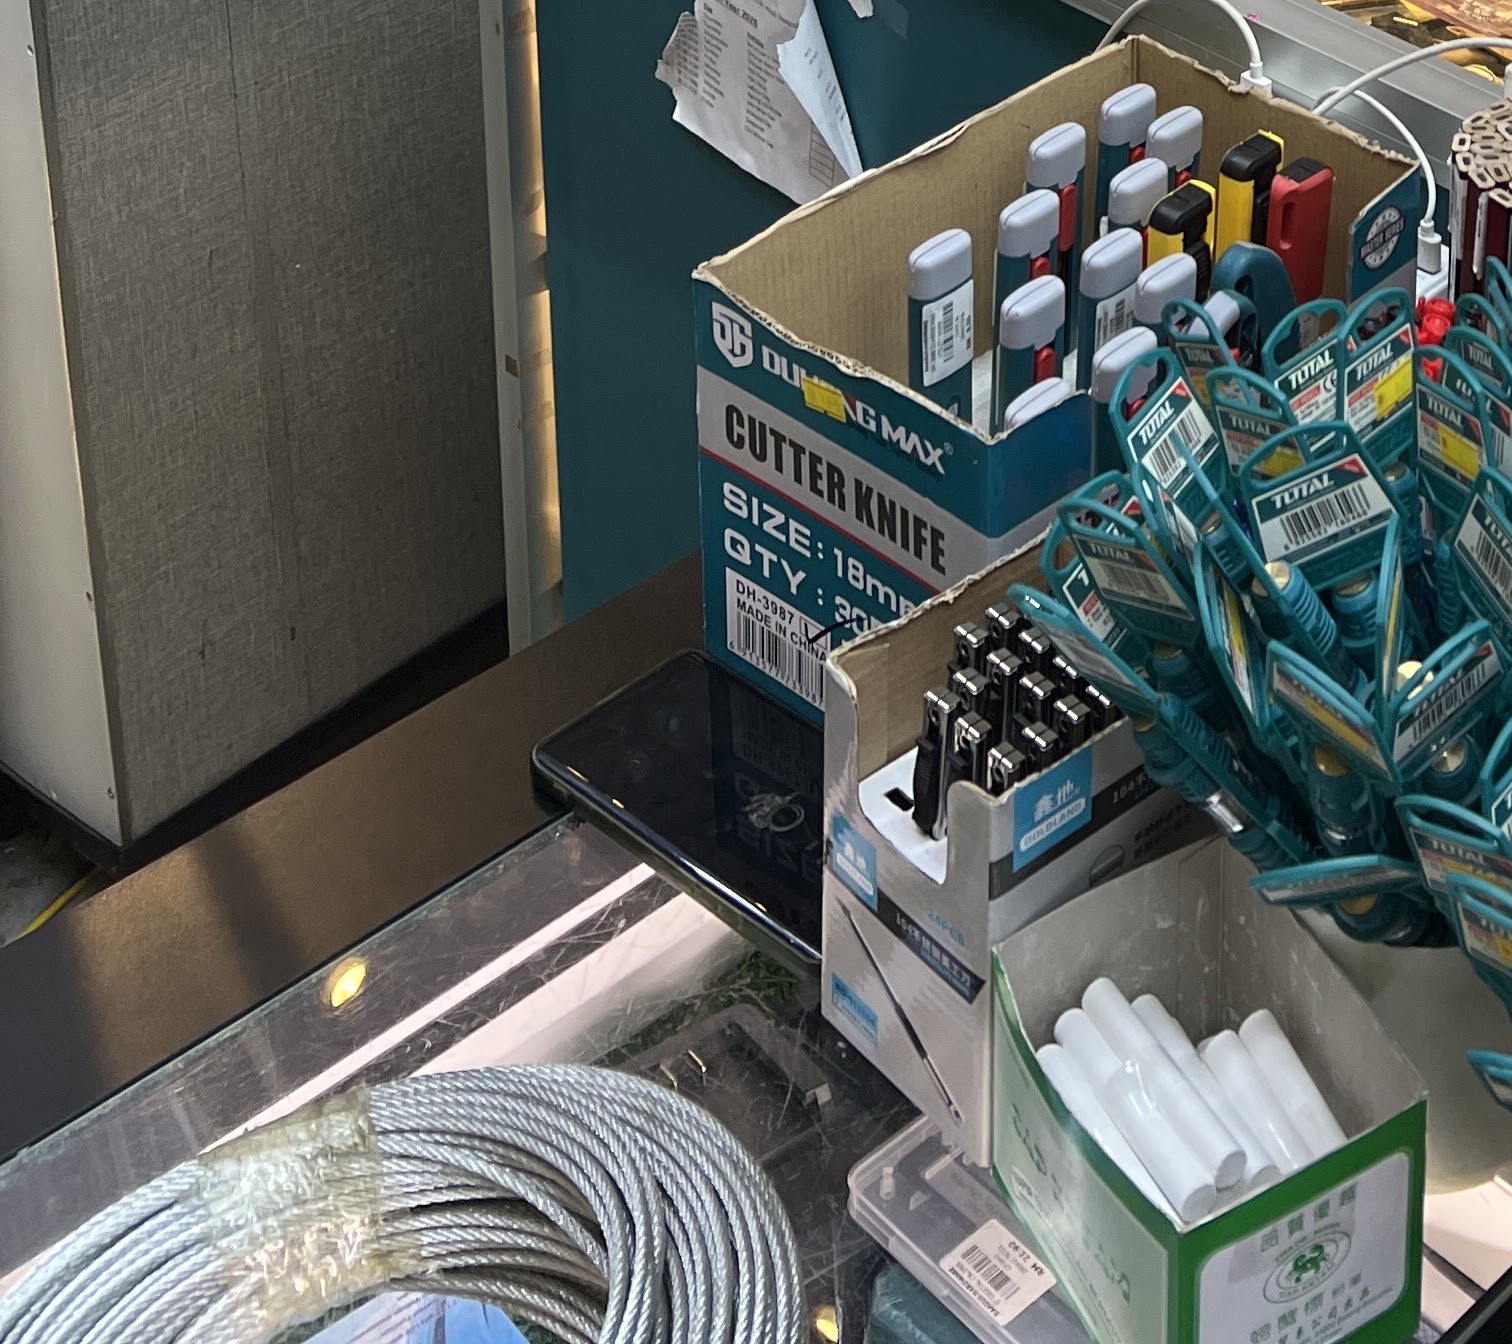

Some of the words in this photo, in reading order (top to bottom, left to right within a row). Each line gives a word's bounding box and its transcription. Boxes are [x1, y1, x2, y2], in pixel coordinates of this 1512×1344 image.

[1288, 349, 1334, 391] TOTAL
[881, 414, 945, 475] MAX
[1139, 405, 1175, 446] TOTAL
[725, 403, 846, 513] CUTTER
[855, 476, 946, 575] KNIFE
[1271, 472, 1336, 510] TOTAL
[724, 528, 806, 595] QTY
[736, 579, 795, 624] DH-3987
[737, 597, 772, 628] MADE
[775, 619, 787, 637] IN
[790, 630, 827, 663] CHINA
[1022, 801, 1084, 849] GOLDLAND
